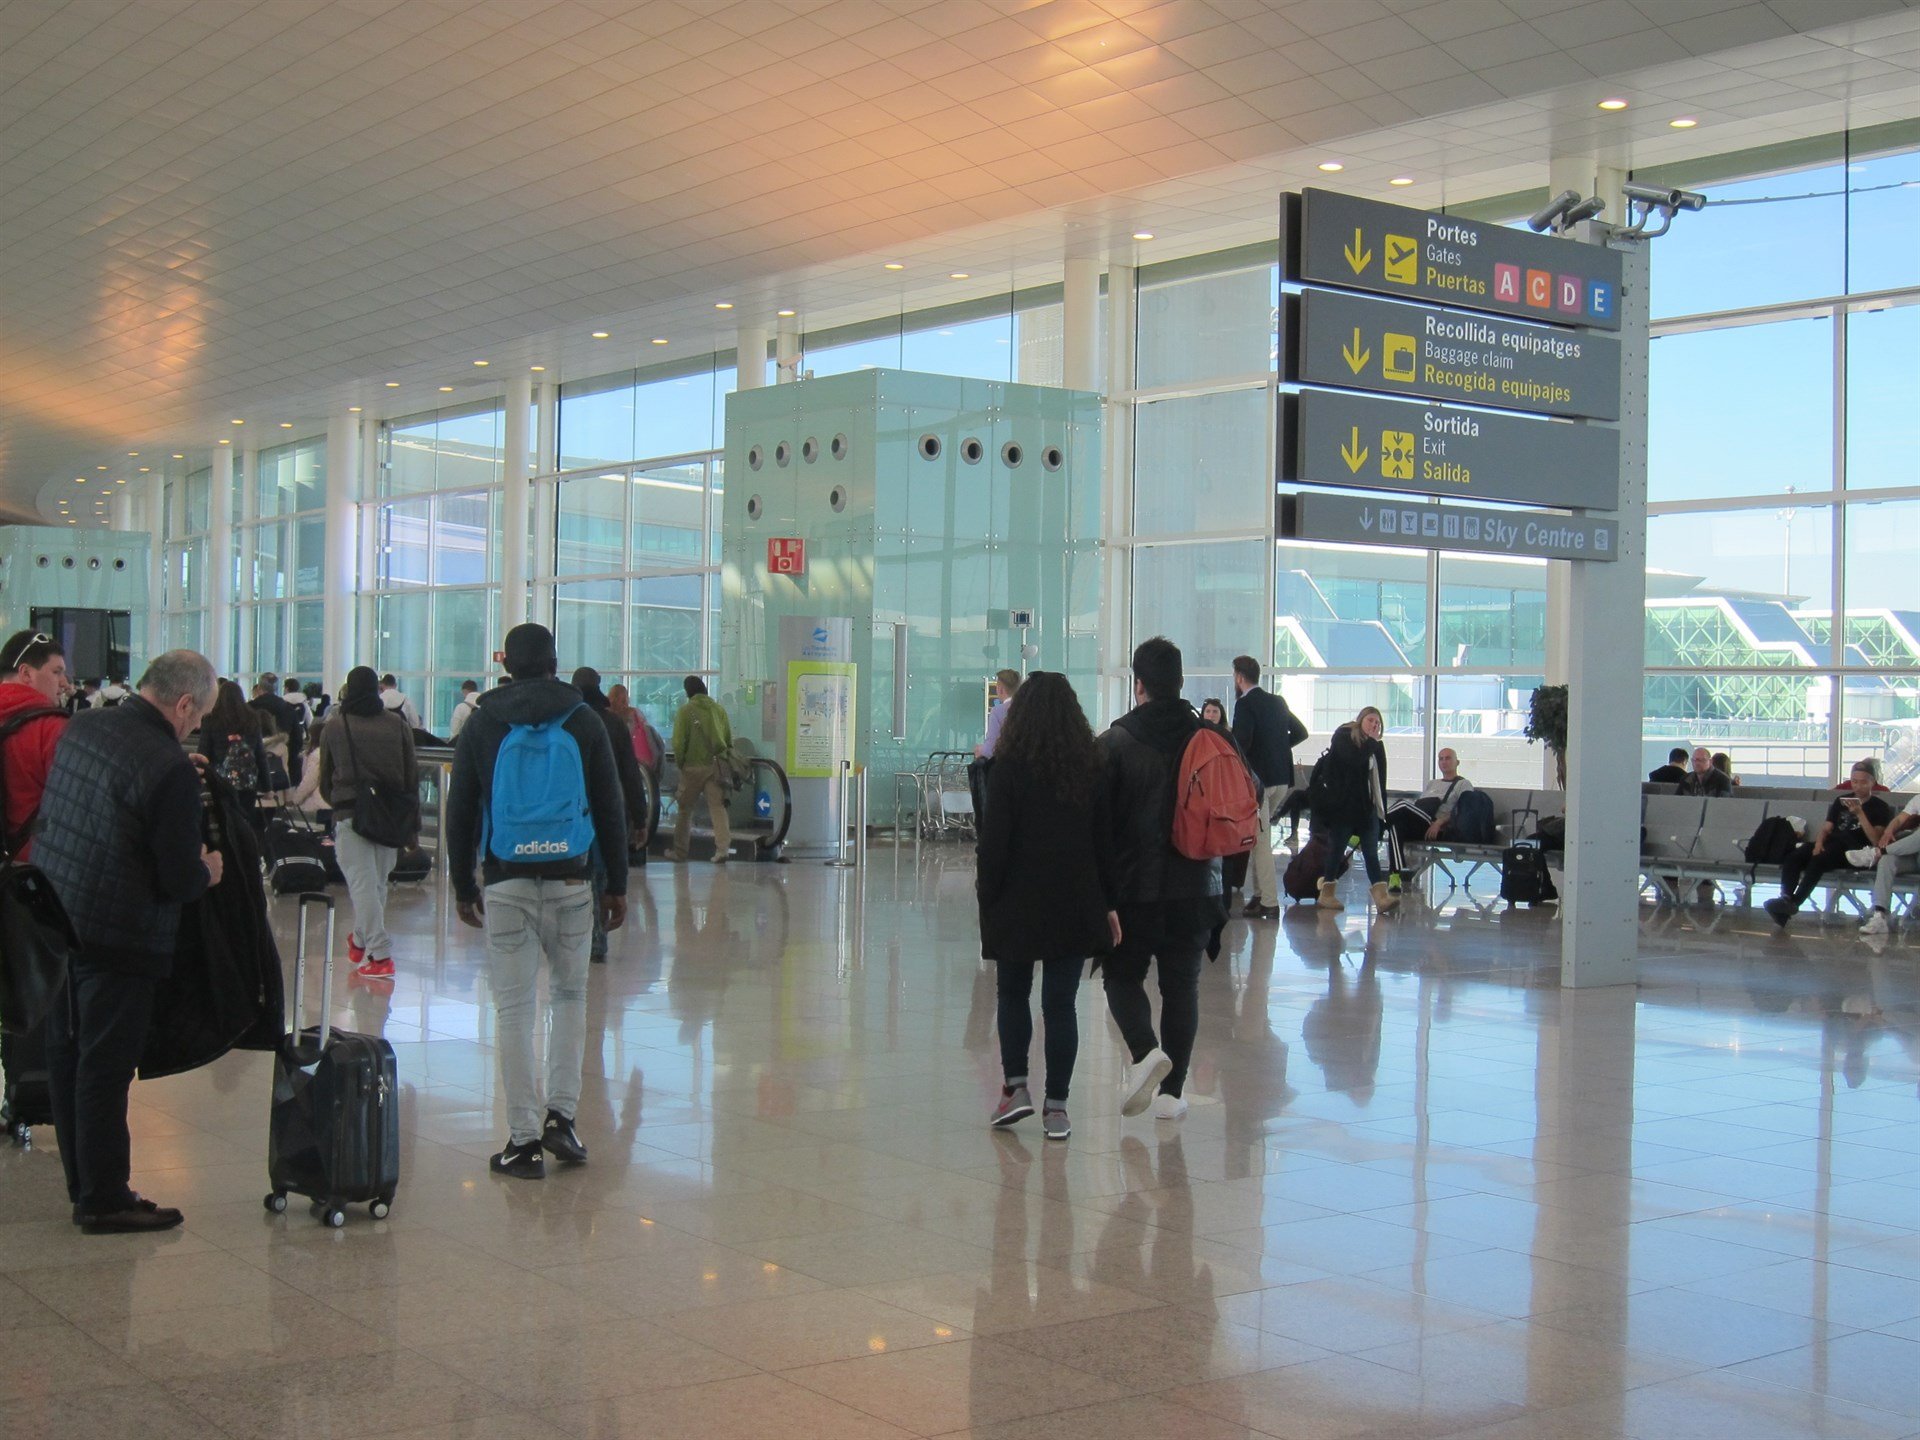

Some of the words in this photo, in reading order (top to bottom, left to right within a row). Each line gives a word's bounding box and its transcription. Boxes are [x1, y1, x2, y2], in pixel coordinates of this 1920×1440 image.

[1428, 219, 1477, 246] Portes
[1427, 244, 1462, 266] Gates
[1427, 267, 1486, 295] Puertas
[1500, 272, 1514, 295] A
[1532, 277, 1545, 301] C
[1564, 282, 1576, 306] D
[1594, 289, 1605, 312] E
[1426, 316, 1496, 345] Recollida
[1502, 332, 1581, 358] equipatges
[1425, 341, 1478, 366] Baggage
[1482, 351, 1513, 370] claim
[1425, 364, 1495, 392] Recogida
[1502, 380, 1571, 404] equipajes
[1424, 412, 1479, 437] Sortida
[1424, 437, 1446, 456] Exit
[1423, 461, 1470, 483] Salida
[1484, 519, 1518, 549] Sky
[1525, 523, 1585, 549] Centre
[515, 840, 568, 854] adidas
